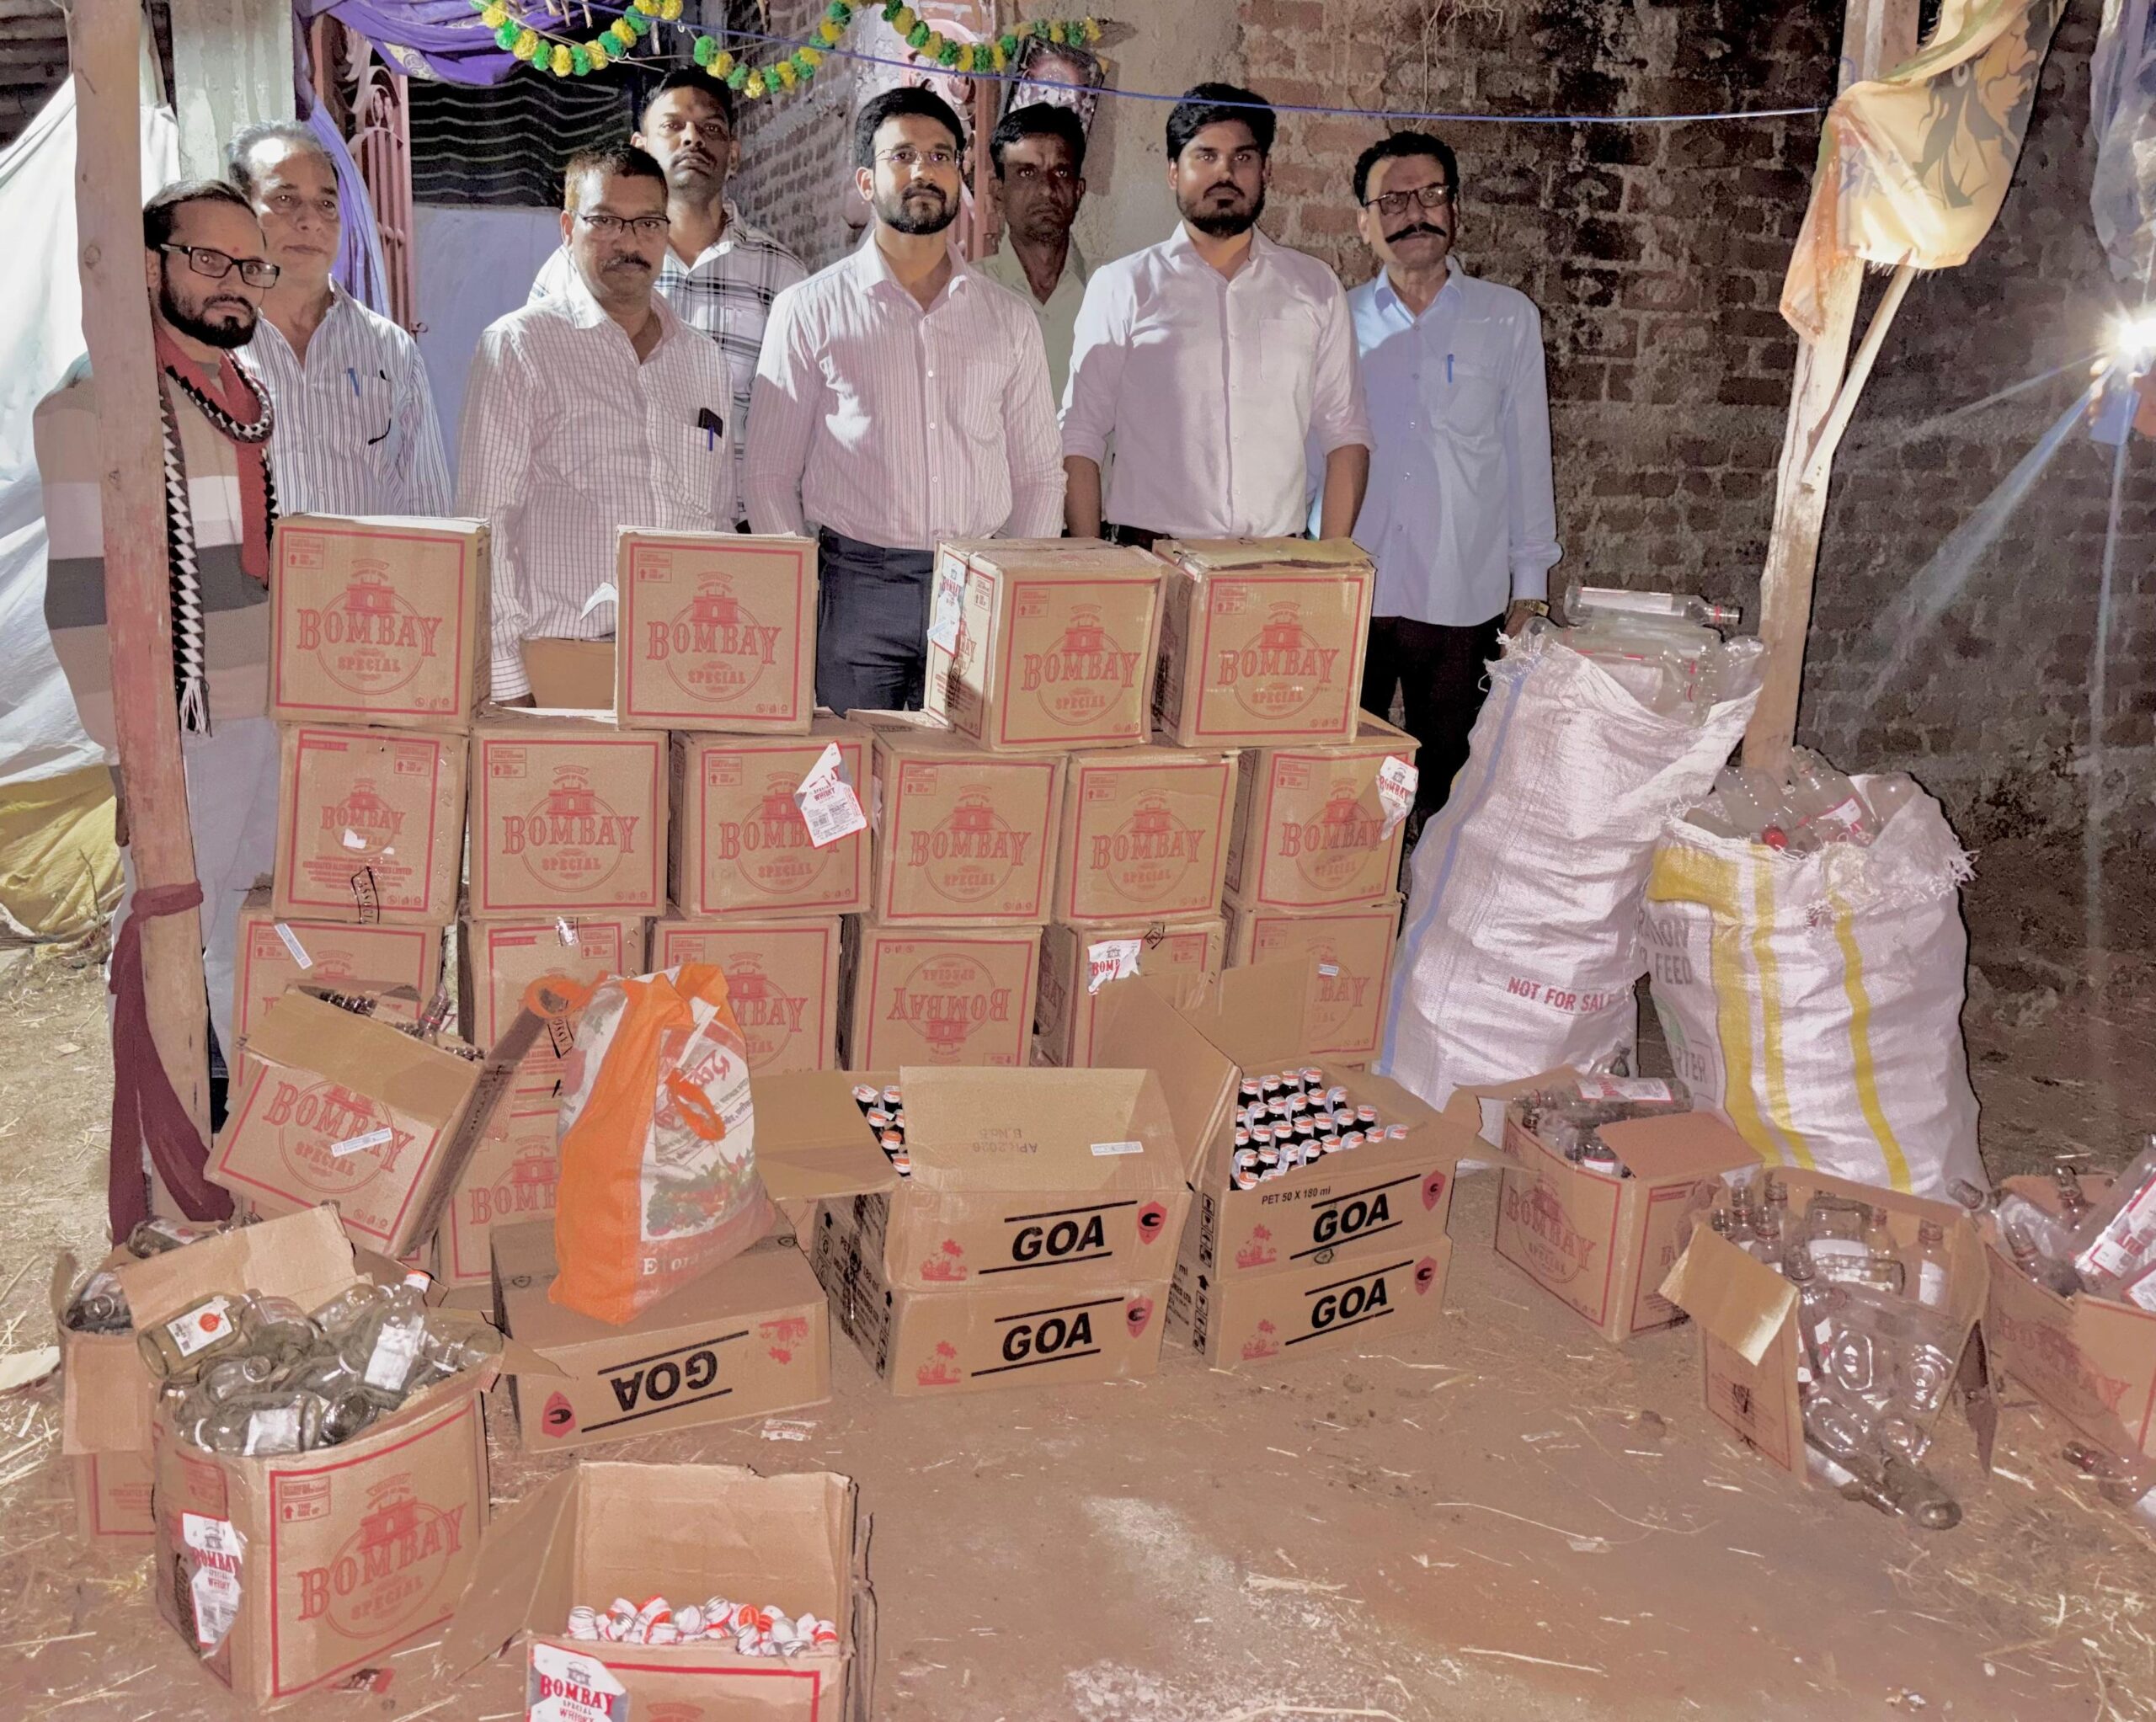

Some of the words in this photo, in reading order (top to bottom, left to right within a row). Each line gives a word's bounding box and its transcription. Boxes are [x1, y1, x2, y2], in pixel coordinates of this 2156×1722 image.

[296, 609, 442, 657] BOMBAY
[647, 621, 782, 664] BOMBAY
[338, 657, 401, 672] SPECIAL
[687, 670, 746, 685] SPECIAL
[1021, 652, 1142, 690] BOMBAY
[1217, 648, 1340, 685] BOMBAY
[1055, 695, 1105, 710] SPECIAL
[1251, 690, 1304, 704] SPECIAL
[321, 806, 406, 834] BOMBAY
[502, 815, 639, 854] BOMBAY
[1278, 818, 1385, 857] BOMBAY
[542, 857, 601, 871] SPECIAL
[908, 830, 1032, 866] BOMBAY
[1090, 829, 1206, 869] BOMBAY
[758, 863, 813, 878] SPECIAL
[1655, 952, 1693, 985] FEED
[886, 988, 1011, 1021] BOMBAY
[1507, 977, 1540, 1000] NOT
[1544, 988, 1577, 1010] FOR
[730, 997, 808, 1032] MBAY
[295, 1141, 356, 1177] SPECIAL
[1262, 1194, 1280, 1205] PET
[1283, 1192, 1292, 1202] 50
[1294, 1192, 1301, 1201] X
[1304, 1188, 1318, 1199] 180
[1320, 1186, 1331, 1196] ml
[1313, 1193, 1390, 1243] GOA
[1506, 1186, 1597, 1272] BOMBAY
[1011, 1214, 1106, 1262] GOA
[1311, 1277, 1388, 1329] GOA
[1001, 1312, 1092, 1362] GOA
[610, 1350, 718, 1412] GOA
[297, 1502, 467, 1621] BOMBAY
[350, 1576, 424, 1619] SPECIAL
[539, 1674, 616, 1716] BOMBAY
[563, 1699, 592, 1715] SPECIAL
